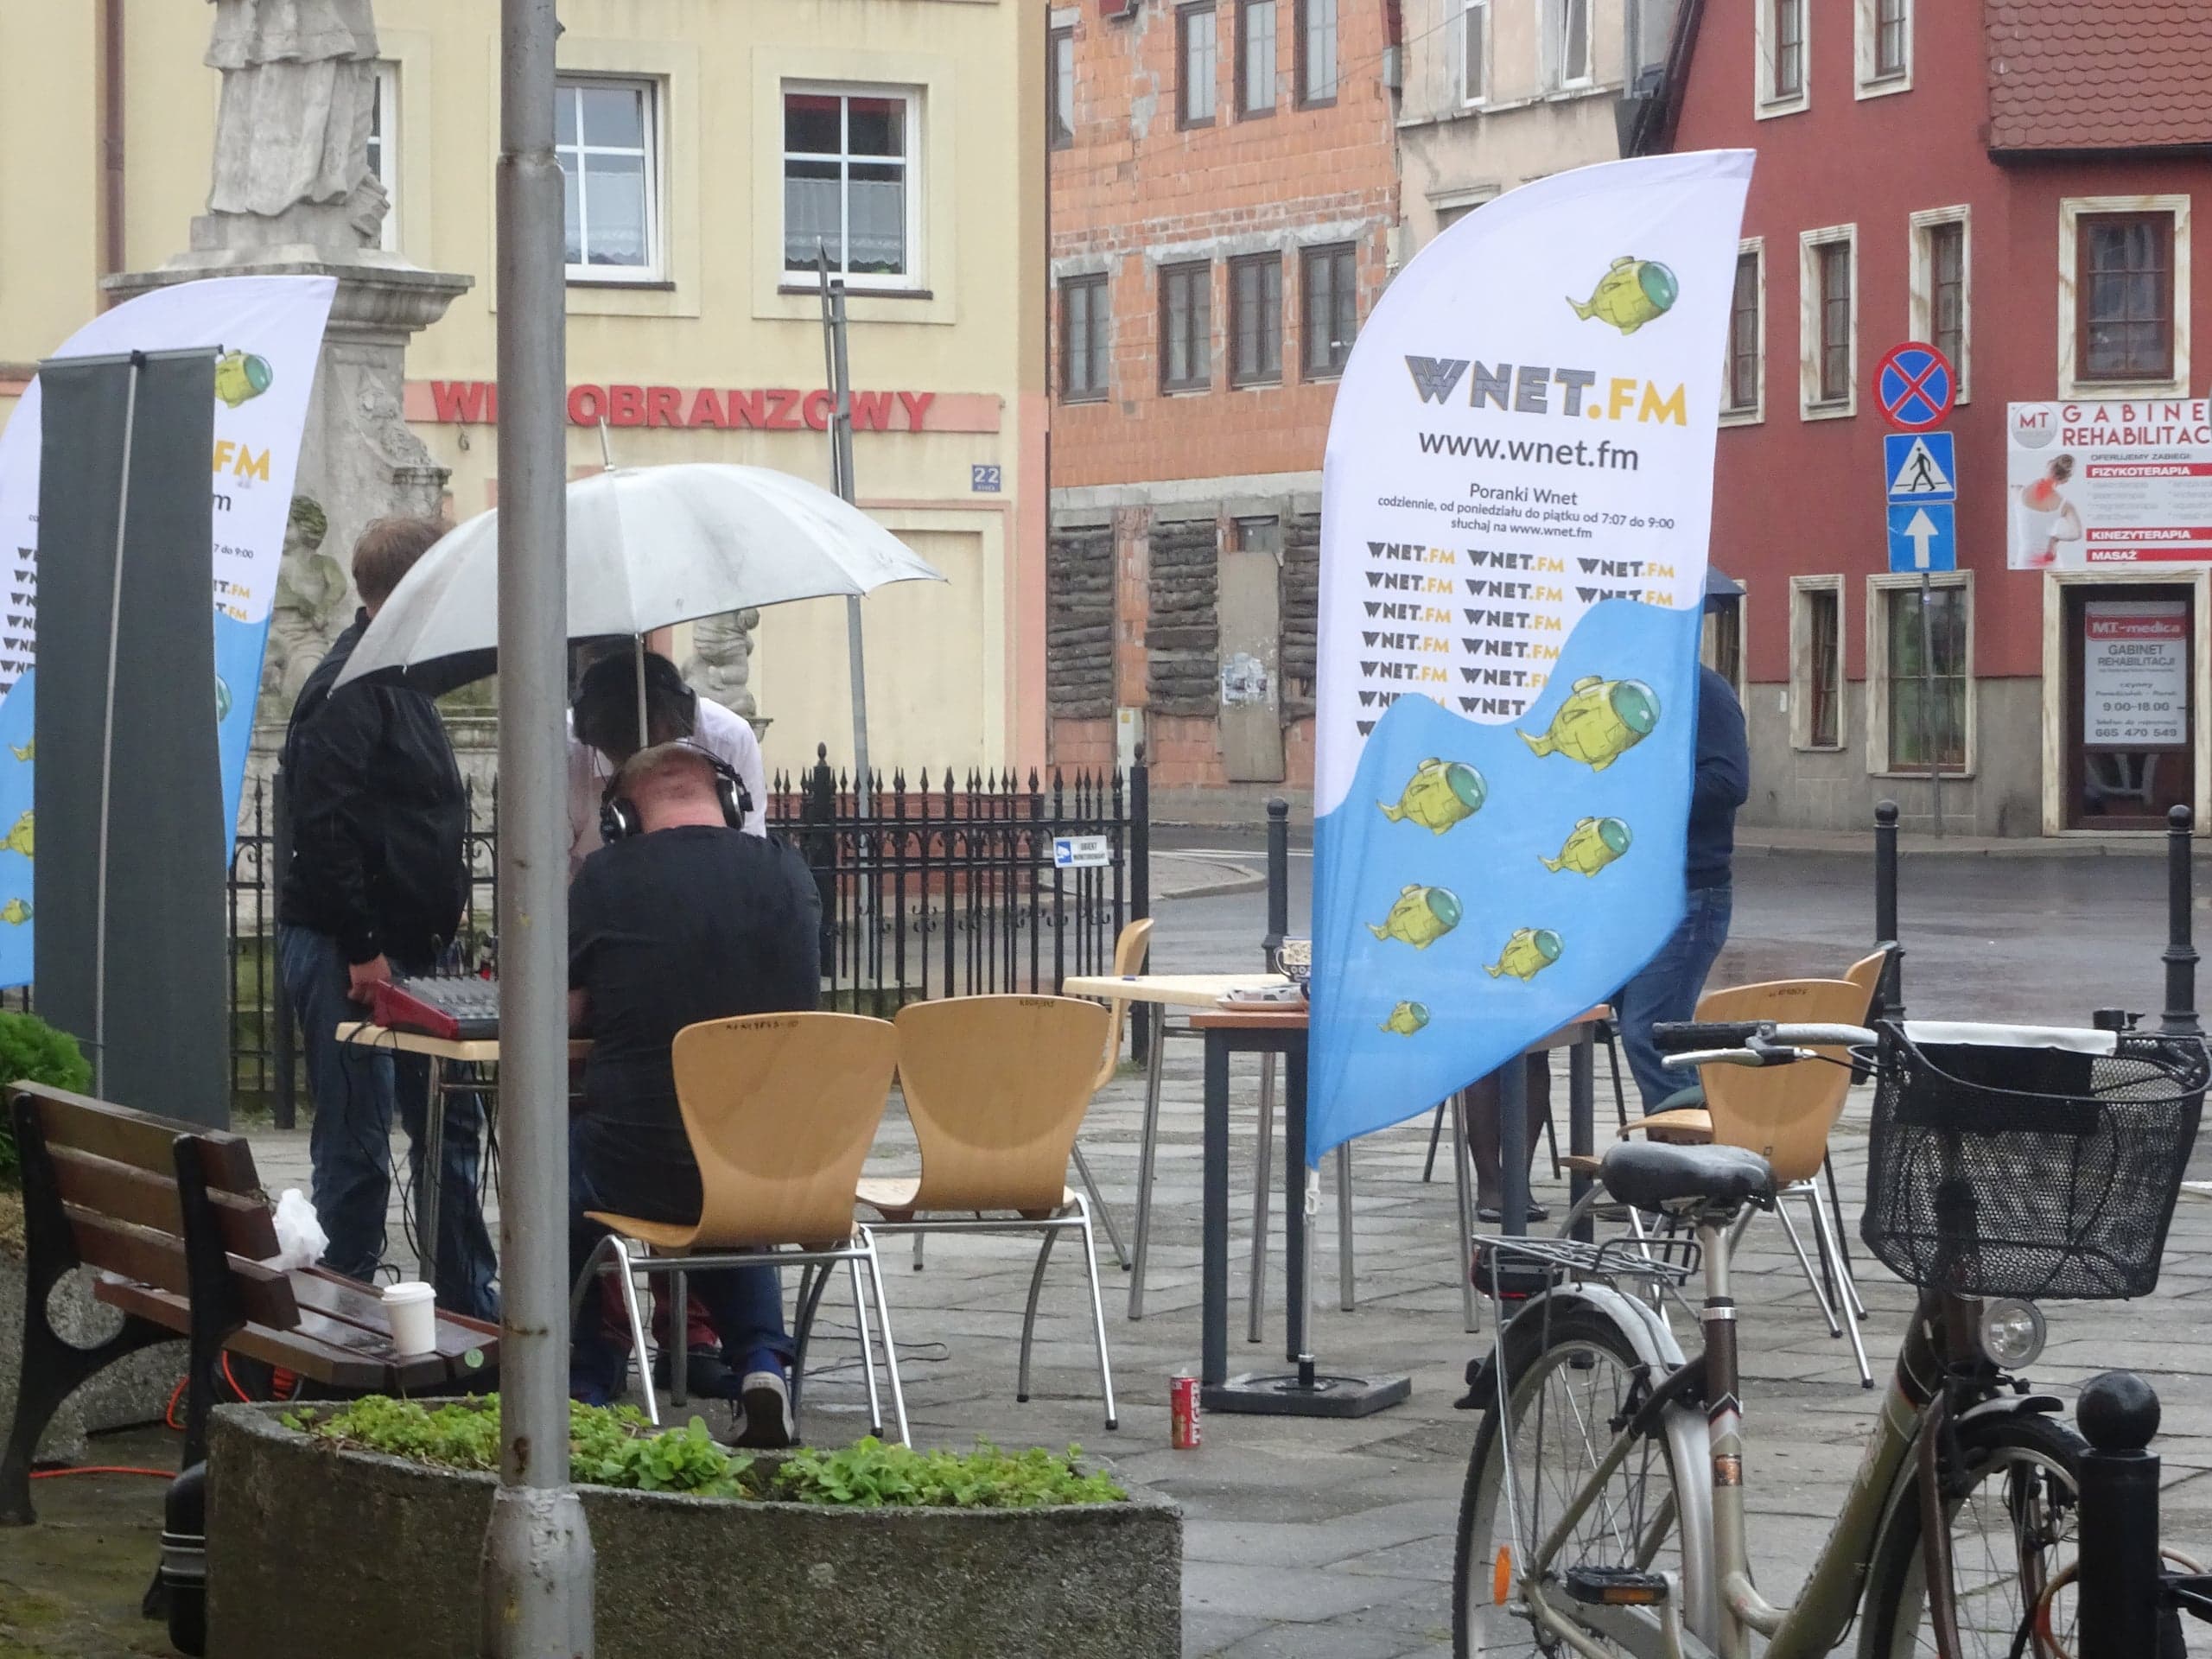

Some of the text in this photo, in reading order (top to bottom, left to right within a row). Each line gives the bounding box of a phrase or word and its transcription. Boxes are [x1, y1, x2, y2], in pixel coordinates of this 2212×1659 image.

[1404, 354, 1687, 426] WNET.FM
[431, 380, 936, 433] WIOBRANZOWY
[2019, 412, 2049, 429] MT
[1420, 432, 1639, 470] www.wnet.fm
[974, 467, 999, 483] 22
[2092, 467, 2190, 476] FIZYKOTERAPIA
[1470, 482, 1578, 505] Poranki Wnet
[1378, 495, 1675, 529] codziennie, od poniedziału do piątku od 7:07 do 9:00
[1451, 518, 1592, 538] słuchaj na www.wnet.fm
[2092, 531, 2191, 540] KINEZYTERAPIA
[221, 544, 233, 555] do
[235, 548, 254, 559] 9:00
[1367, 542, 1675, 578] WNET.FM WNET.FM WNET.FM
[2092, 550, 2137, 560] MASAŻ
[1365, 571, 1453, 594] WNET.FM
[1465, 579, 1563, 601] WNET.FM
[1363, 601, 1561, 631] WNET.FM WNET.FM
[1362, 631, 1560, 659] WNET.FM WNET.FM
[2108, 644, 2164, 655] GABINET
[1360, 661, 1447, 682] WNET.FM
[2097, 658, 2176, 666] REHABILITACJI
